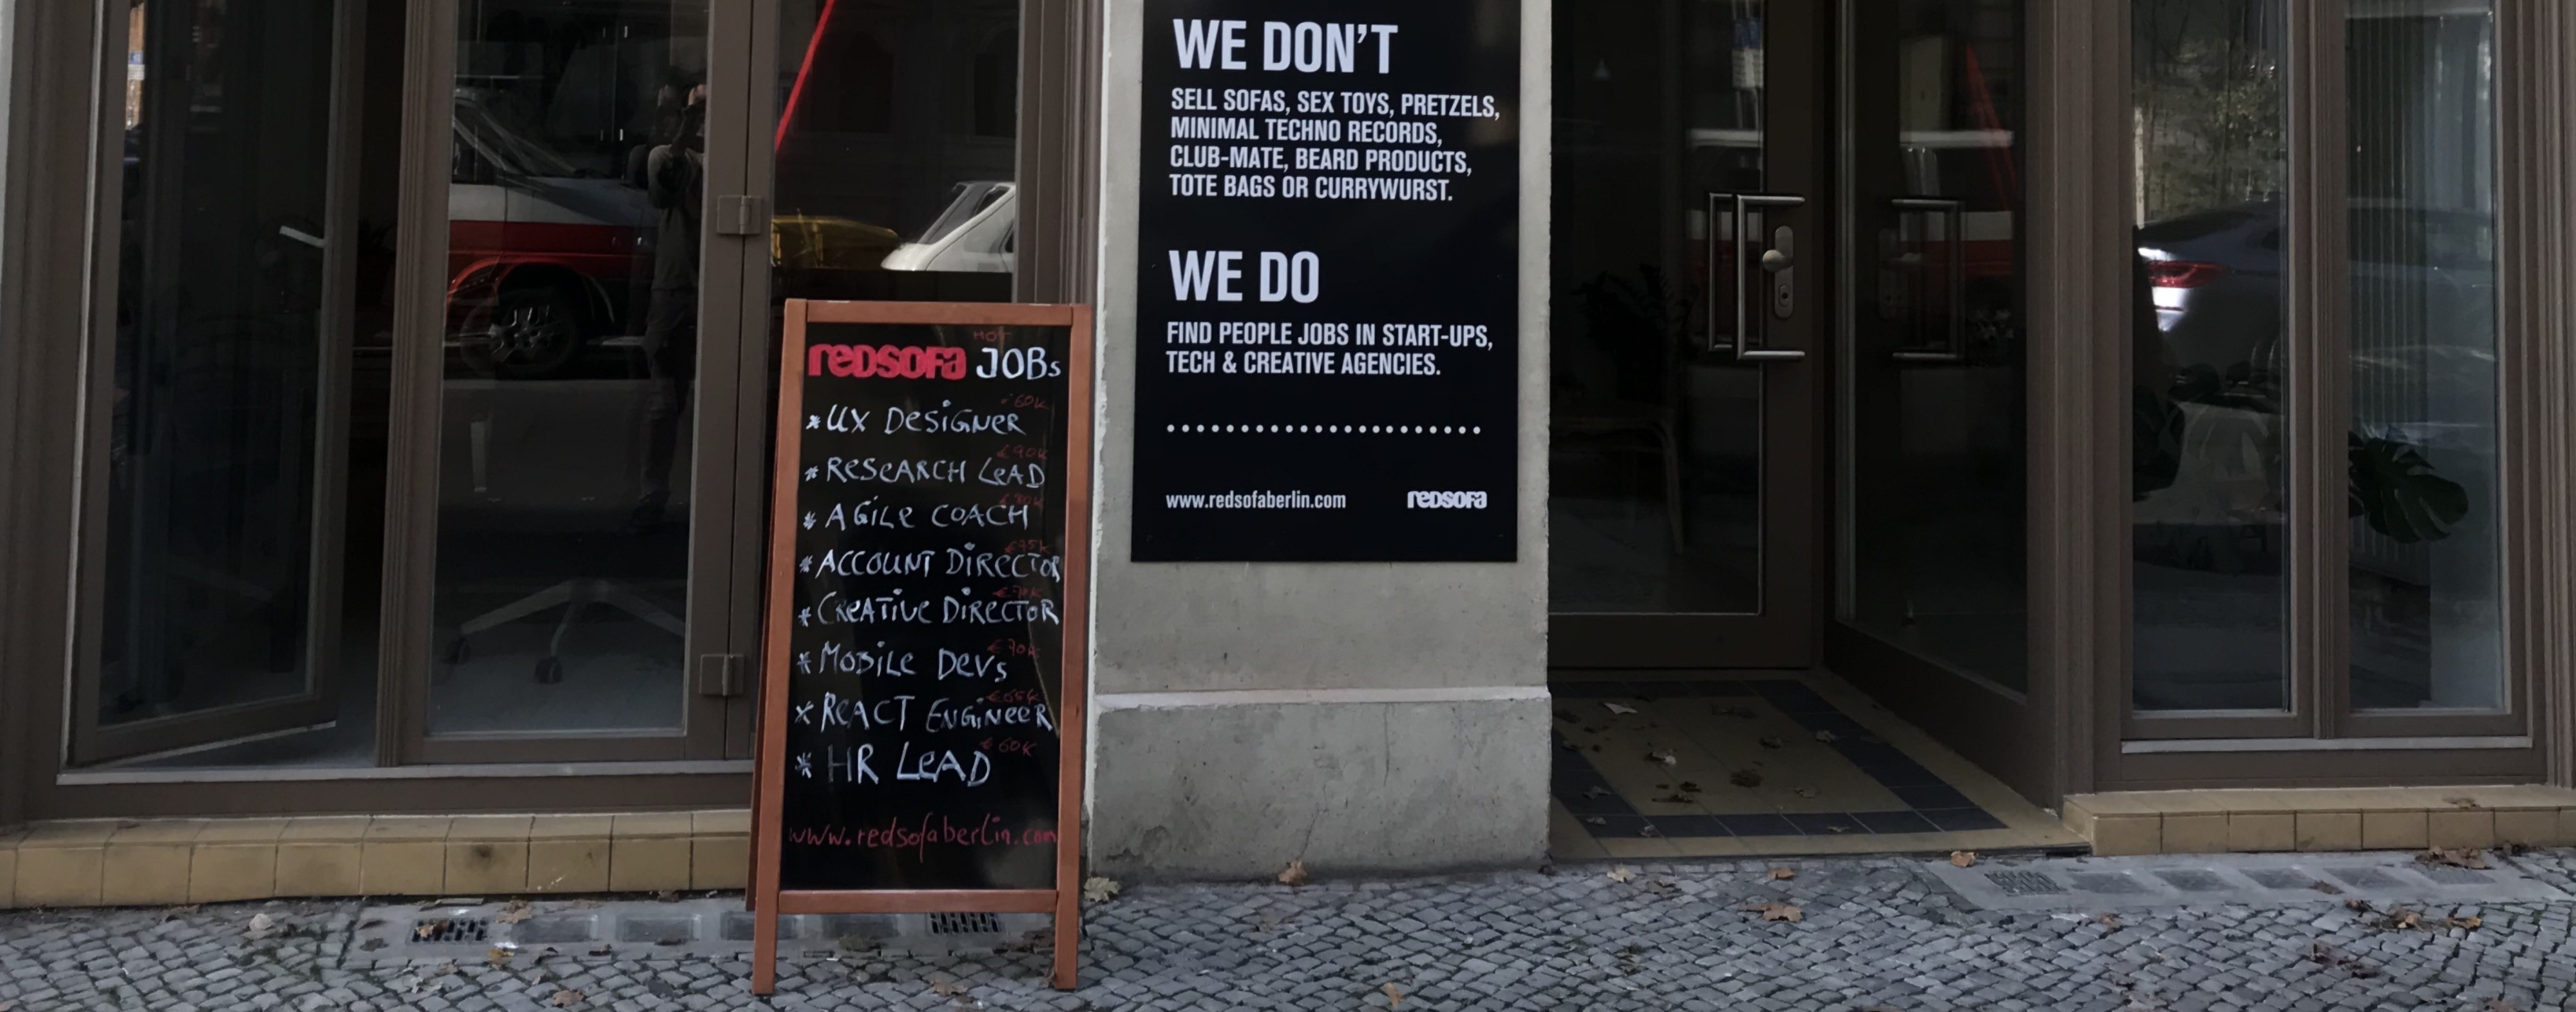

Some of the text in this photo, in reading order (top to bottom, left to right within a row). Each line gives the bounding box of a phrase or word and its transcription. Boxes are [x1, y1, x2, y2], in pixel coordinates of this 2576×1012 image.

[1173, 19, 1397, 73] WE DON’T
[1172, 88, 1499, 120] SELL SOFAS, SEX TOYS, PRETZELS,
[1172, 117, 1442, 147] MINIMAL TECHNO RECORDS,
[1171, 145, 1471, 176] CLUB-MATE, BEARD PRODUCTS,
[1170, 174, 1452, 200] TOTE BAGS OR CURRYWURST.
[1169, 251, 1319, 303] WE DO
[1167, 322, 1492, 350] FIND PEOPLE JOBS IN START-UPS,
[1166, 351, 1440, 375] TECH & CREATIVE AGENCIES.
[827, 403, 870, 433] UX
[1166, 490, 1346, 508] www.redsofaberlin.com
[932, 504, 1028, 531] COACH
[815, 548, 935, 579] ACCOUNT
[828, 743, 879, 785] HR
[789, 812, 1057, 863] www.redsofaberlin.com
